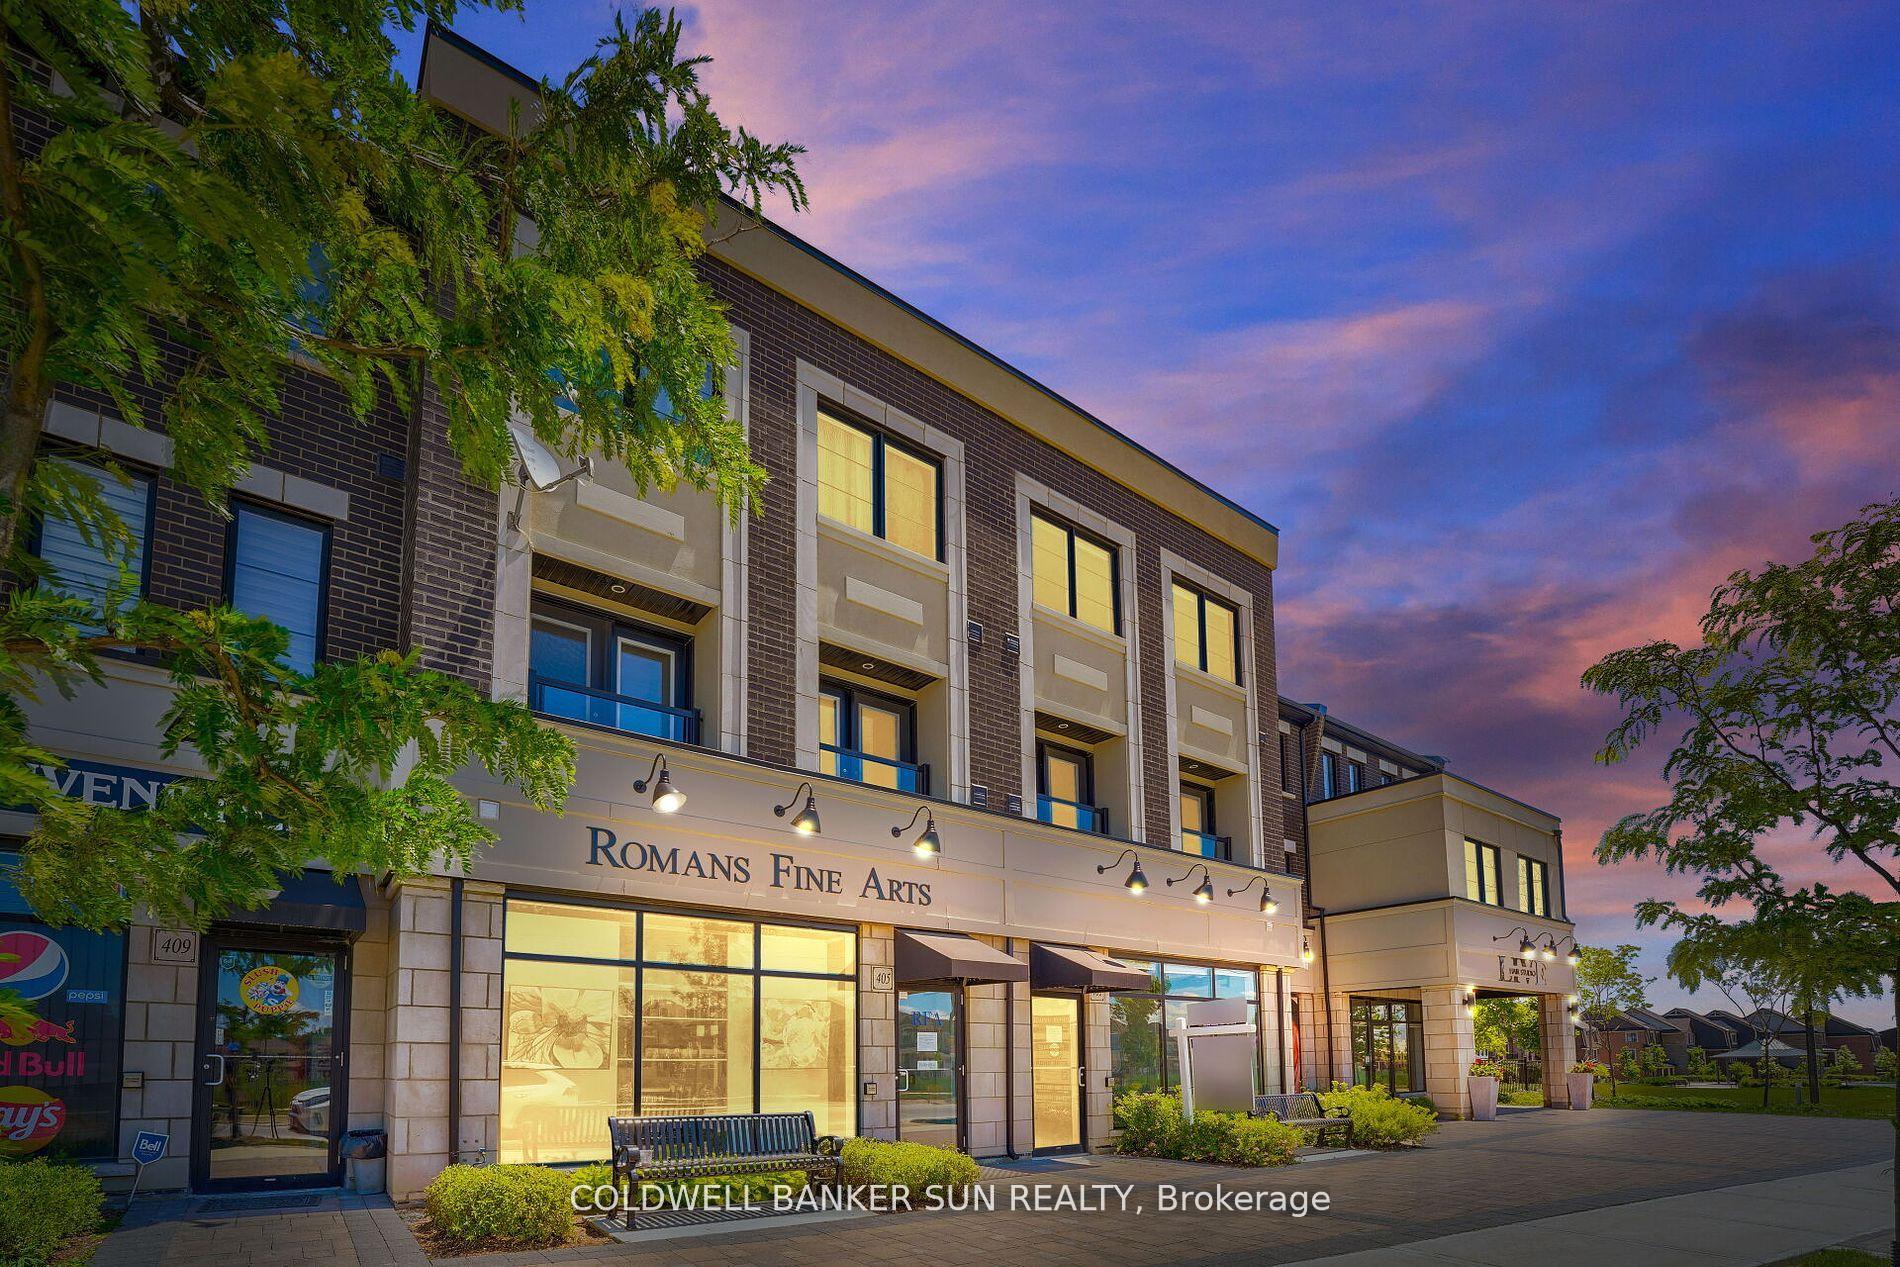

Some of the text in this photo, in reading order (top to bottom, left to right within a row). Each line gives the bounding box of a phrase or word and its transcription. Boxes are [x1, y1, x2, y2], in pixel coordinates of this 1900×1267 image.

[585, 826, 932, 906] ROMANS FINE ARTS
[161, 938, 191, 954] 409
[876, 973, 891, 985] 405
[68, 991, 105, 1001] pepsi
[19, 1051, 86, 1077] Bull
[0, 1100, 62, 1141] ay's
[140, 1139, 162, 1151] Bell
